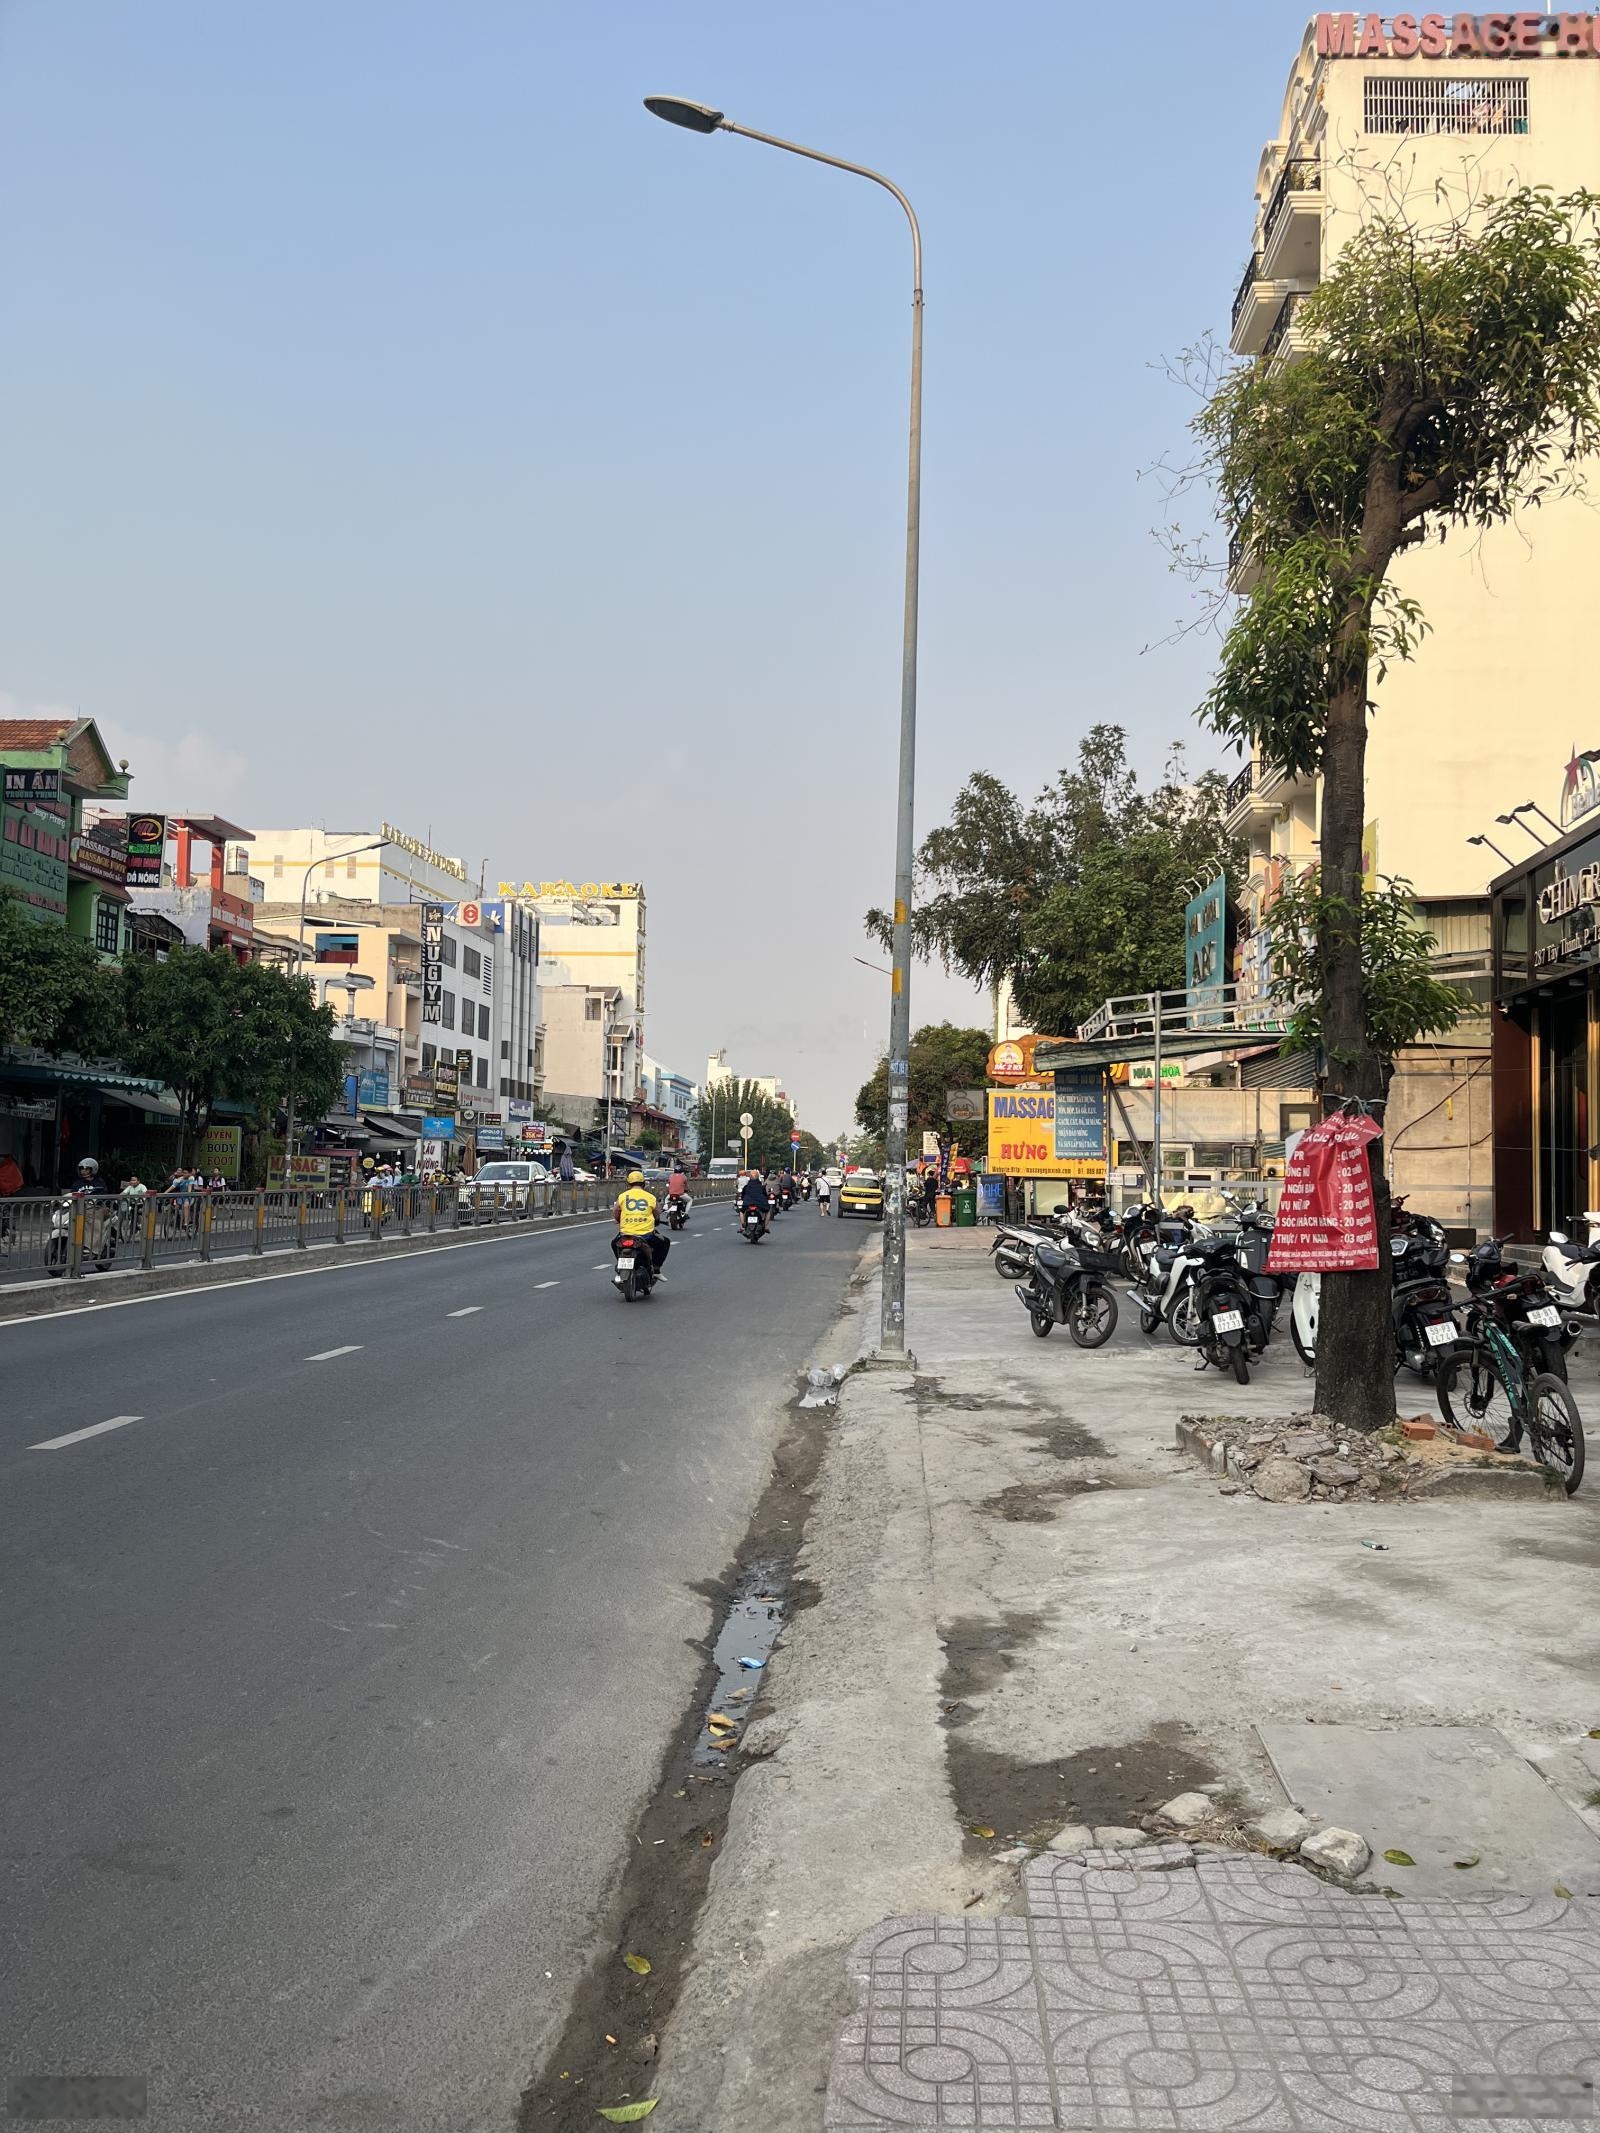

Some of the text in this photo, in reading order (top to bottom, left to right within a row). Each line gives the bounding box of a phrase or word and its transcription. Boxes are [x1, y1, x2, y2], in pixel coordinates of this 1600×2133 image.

[6, 774, 26, 790] IN
[79, 837, 110, 857] MASSAGE
[137, 871, 159, 884] NÓNG
[498, 881, 638, 898] KARAOKE
[994, 1096, 1055, 1119] MASSAG
[207, 1143, 236, 1153] BODY
[1001, 1140, 1048, 1160] HƯNG
[207, 1156, 235, 1165] FOOT
[1294, 1150, 1305, 1161] PR
[1341, 1167, 1351, 1177] 02
[1342, 1183, 1353, 1193] 20
[625, 1194, 649, 1212] be
[1281, 1200, 1291, 1212] VỤ
[1343, 1200, 1354, 1210] 20
[1281, 1215, 1297, 1227] SÓC
[1344, 1217, 1355, 1227] 20
[1300, 1234, 1310, 1244] PV
[1312, 1234, 1329, 1244] NAM
[1344, 1233, 1355, 1244] 03
